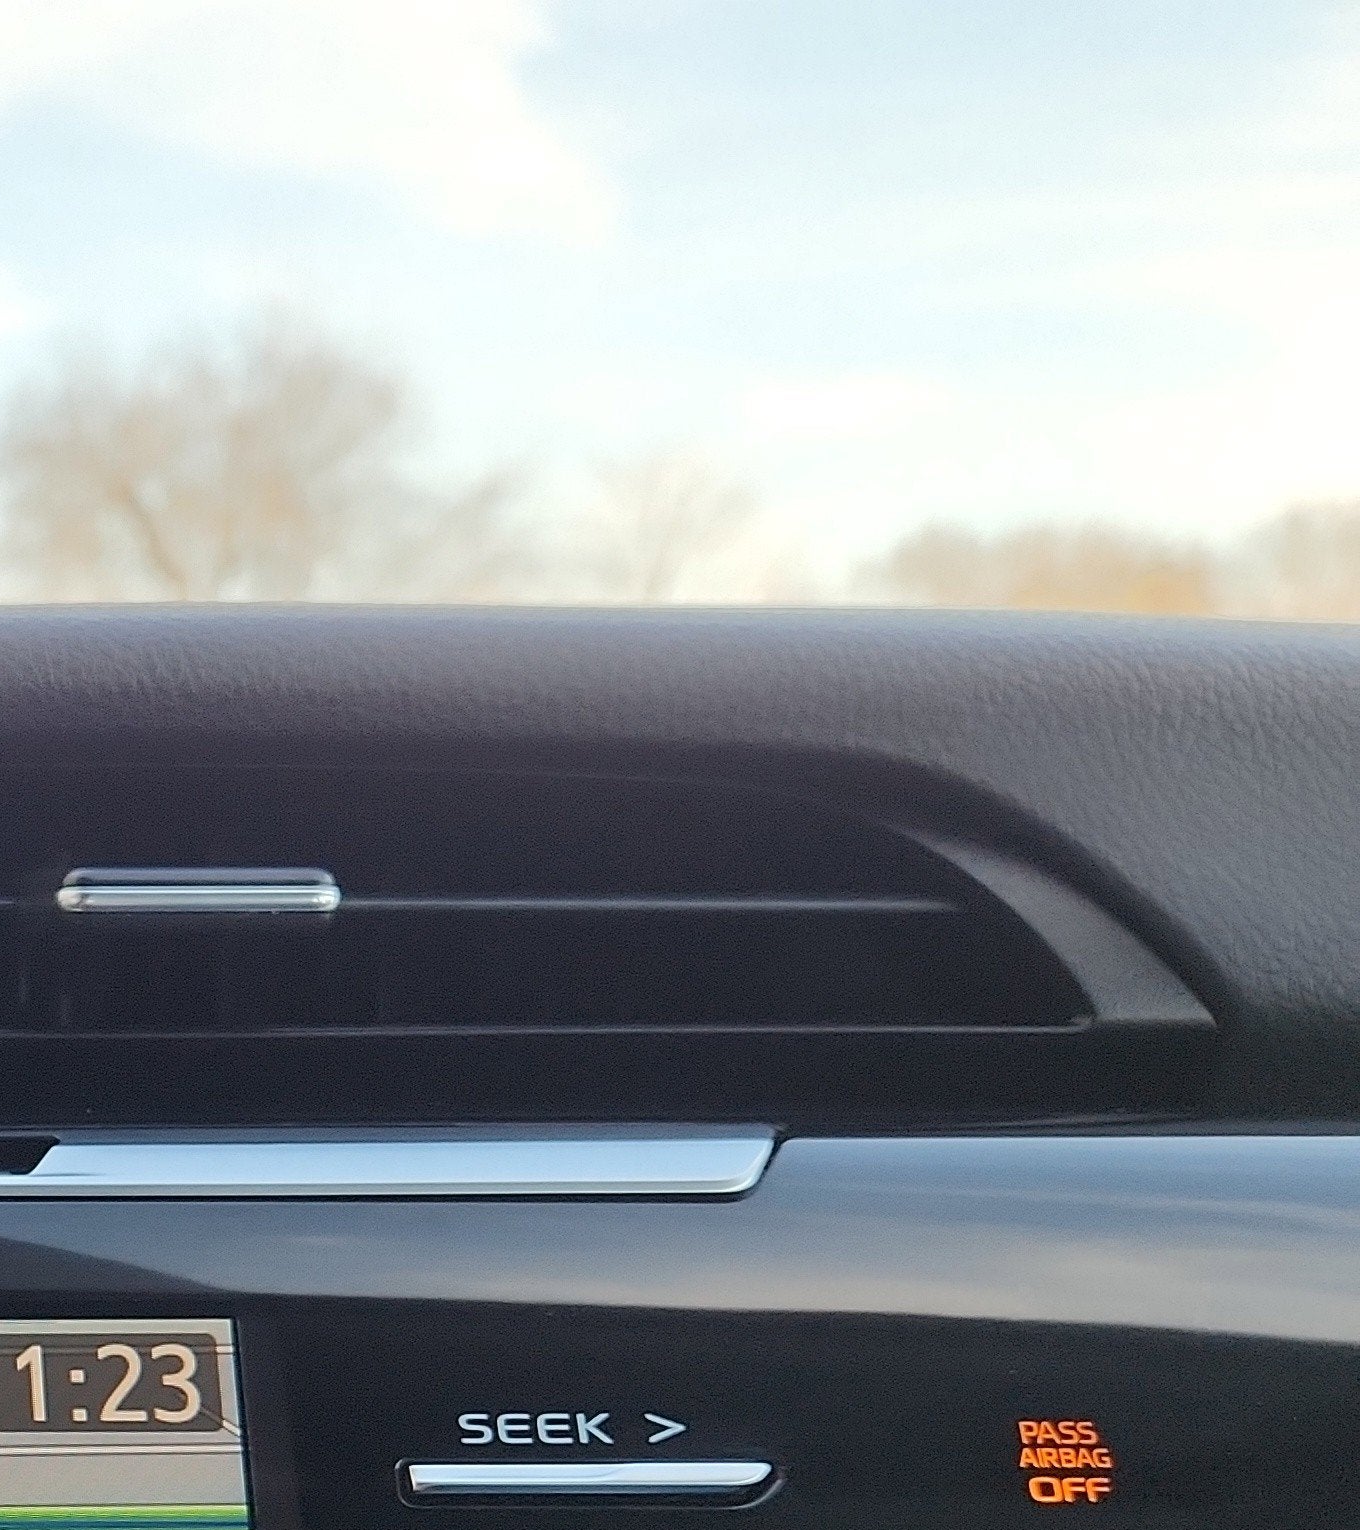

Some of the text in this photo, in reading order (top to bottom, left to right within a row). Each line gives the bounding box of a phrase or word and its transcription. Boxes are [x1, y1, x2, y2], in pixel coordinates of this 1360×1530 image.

[15, 1342, 202, 1424] 1:23
[456, 1410, 616, 1446] SEEK
[1018, 1420, 1099, 1445] PASS
[1019, 1446, 1113, 1469] AIRBAG
[1028, 1476, 1111, 1503] OFF
